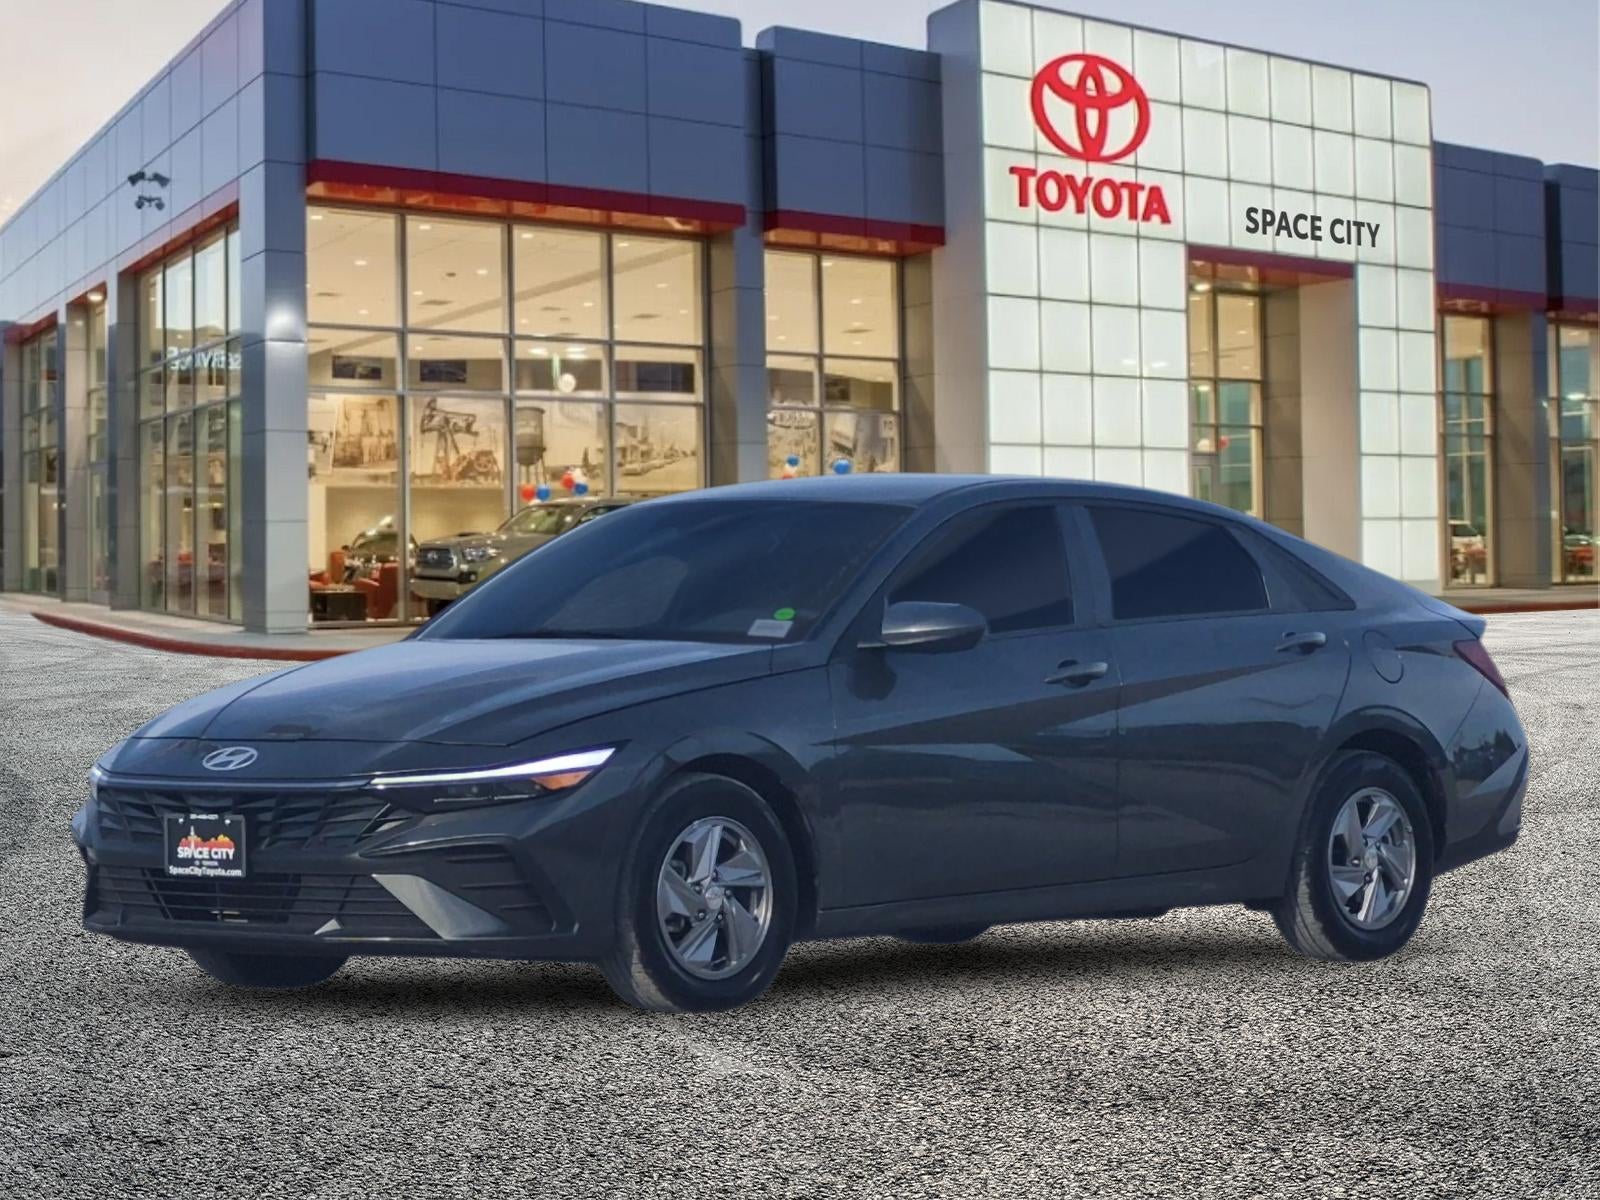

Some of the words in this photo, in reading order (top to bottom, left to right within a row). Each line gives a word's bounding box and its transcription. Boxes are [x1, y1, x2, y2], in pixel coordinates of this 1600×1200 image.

[1009, 166, 1171, 224] TOYOTA
[1245, 206, 1323, 242] SPACE
[1329, 218, 1381, 248] CITY
[177, 847, 209, 859] SPACE
[211, 848, 235, 860] CITY
[169, 865, 242, 876] SpaceCityToyota.com
